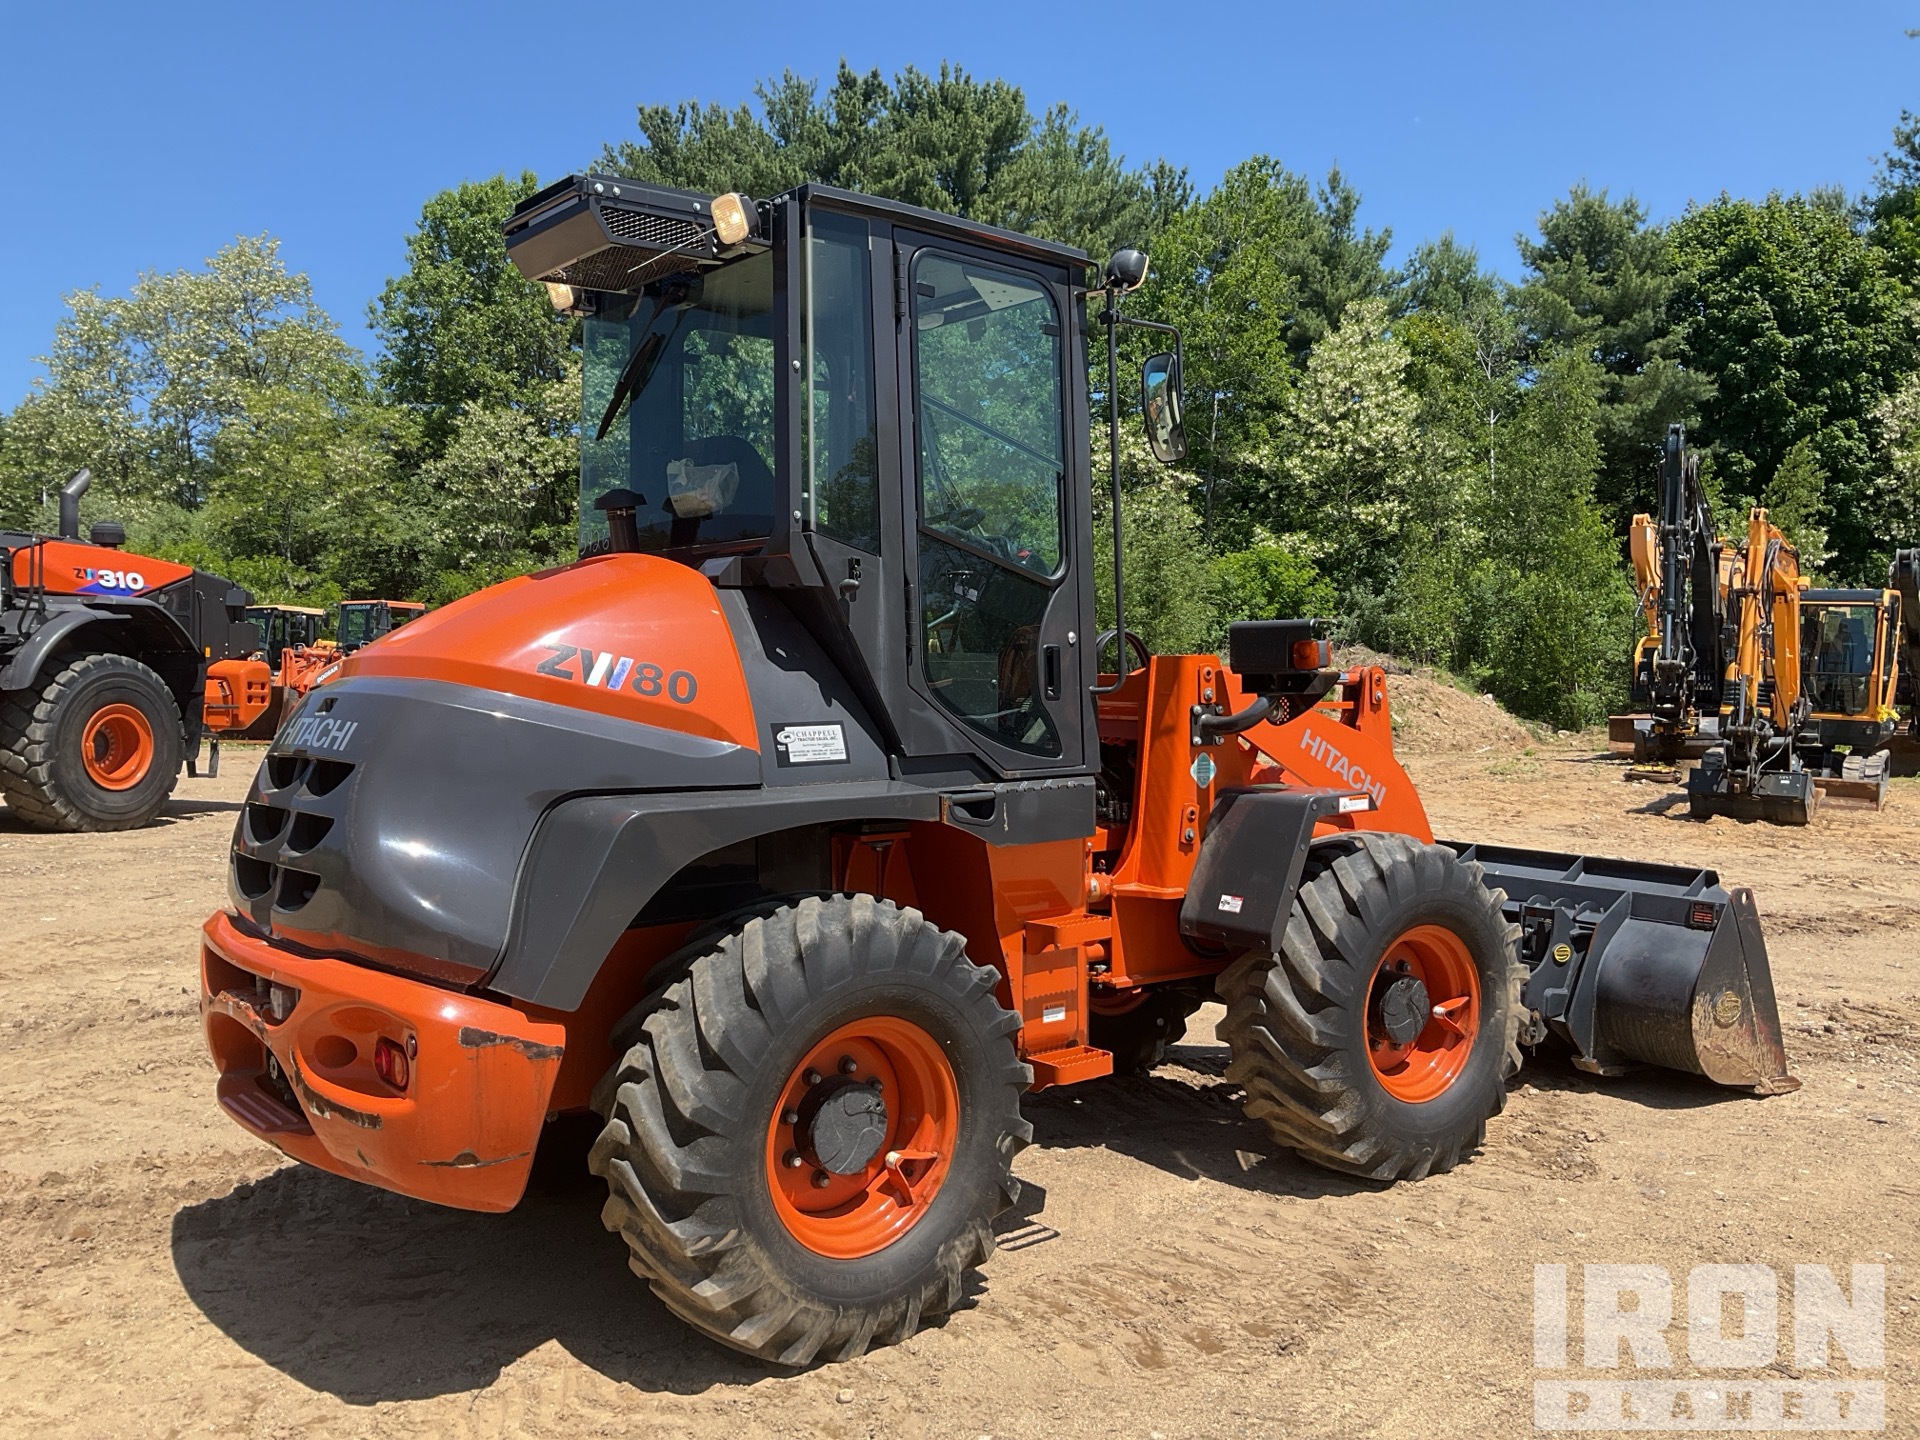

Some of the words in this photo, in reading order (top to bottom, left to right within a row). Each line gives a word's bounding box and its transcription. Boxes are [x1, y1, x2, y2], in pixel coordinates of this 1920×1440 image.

[536, 643, 699, 705] ZW80
[280, 716, 358, 752] HITACHI
[1301, 728, 1386, 807] HITACHI
